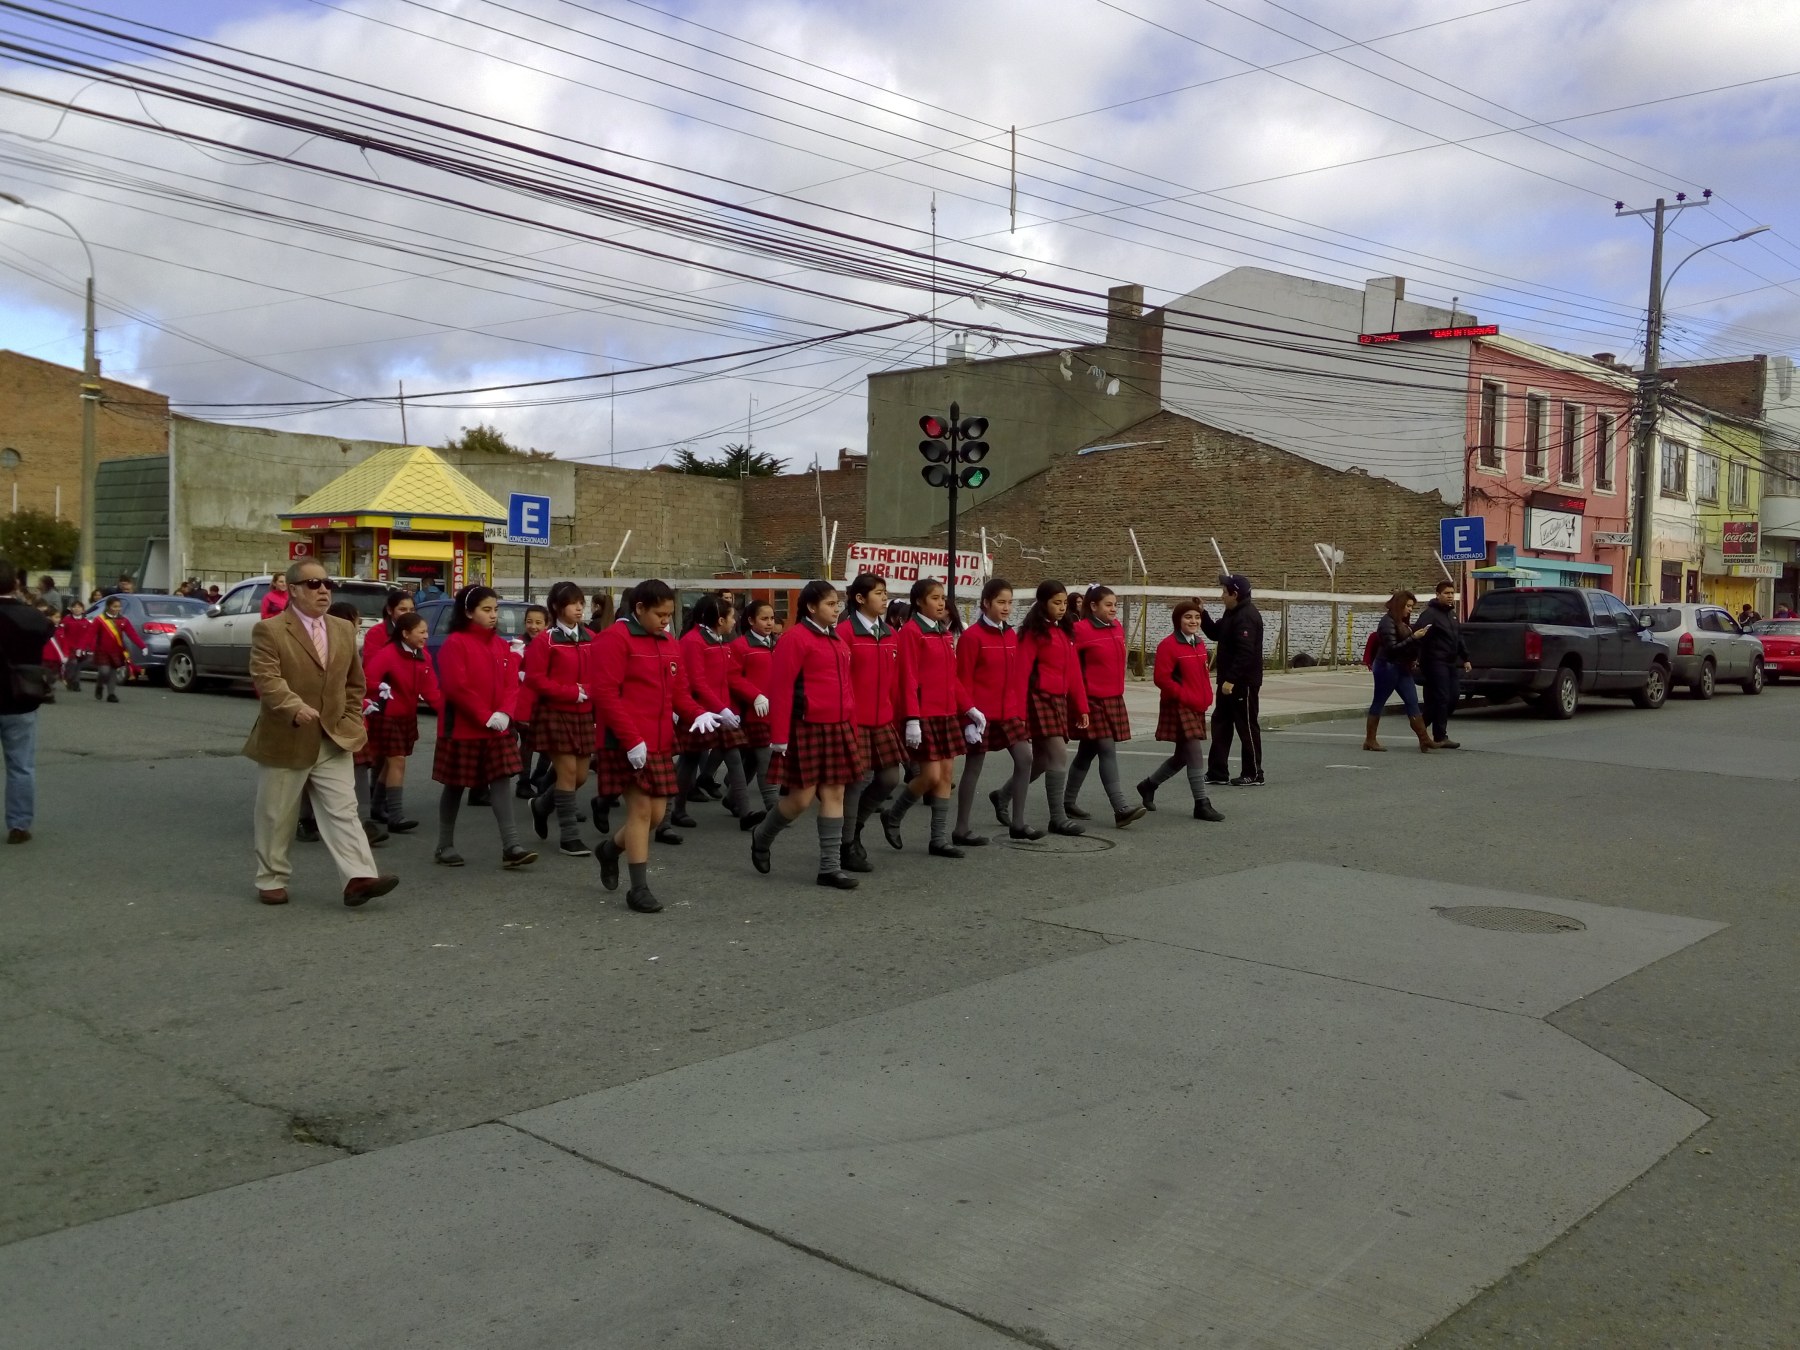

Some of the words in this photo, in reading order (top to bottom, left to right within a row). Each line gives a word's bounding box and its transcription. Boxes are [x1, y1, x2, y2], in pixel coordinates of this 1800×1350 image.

[522, 502, 540, 534] E
[509, 535, 548, 545] CONCESIONADO
[1454, 526, 1471, 552] E
[850, 546, 979, 570] ESTACIONAMIENTO
[1443, 552, 1484, 560] CONCESIONADO
[454, 549, 464, 596] RECAR
[858, 563, 919, 581] PUBLICO
